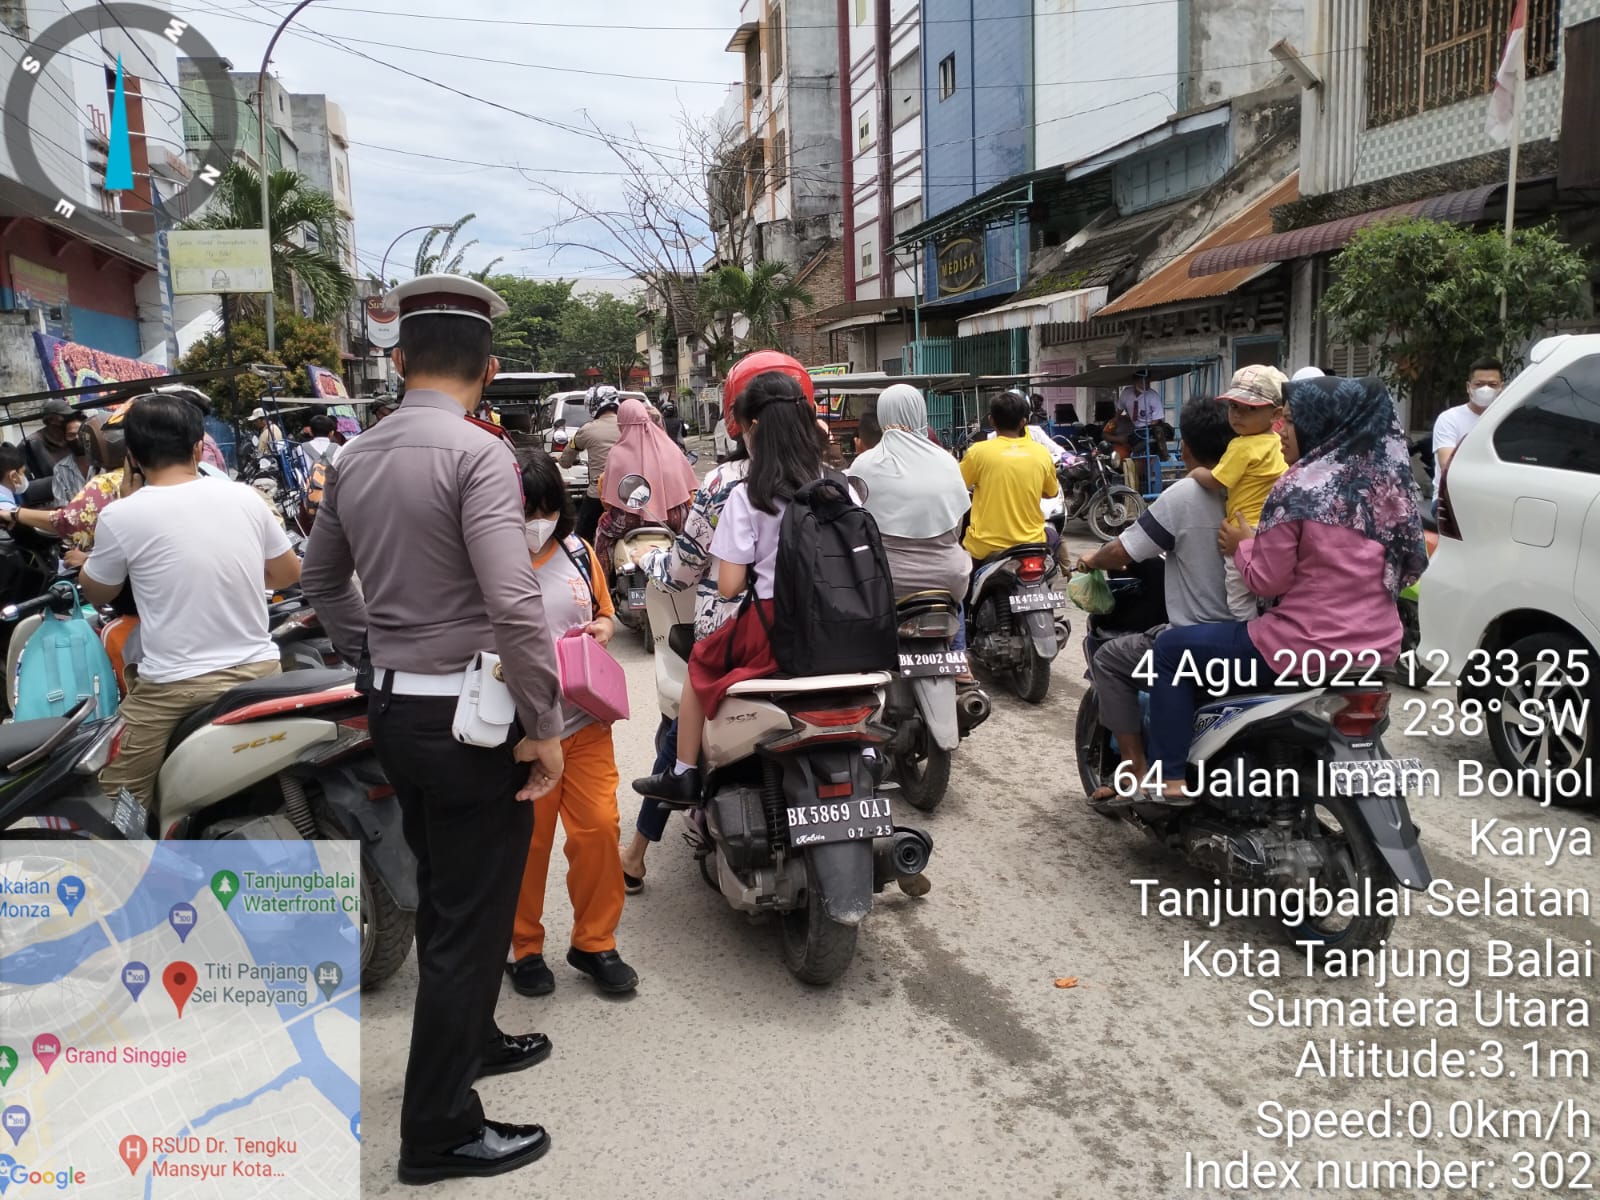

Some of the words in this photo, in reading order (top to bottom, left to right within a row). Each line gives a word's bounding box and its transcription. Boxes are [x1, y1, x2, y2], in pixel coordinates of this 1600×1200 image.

[941, 254, 976, 277] MEDISA
[945, 652, 967, 664] QAA
[859, 799, 891, 819] QAJ
